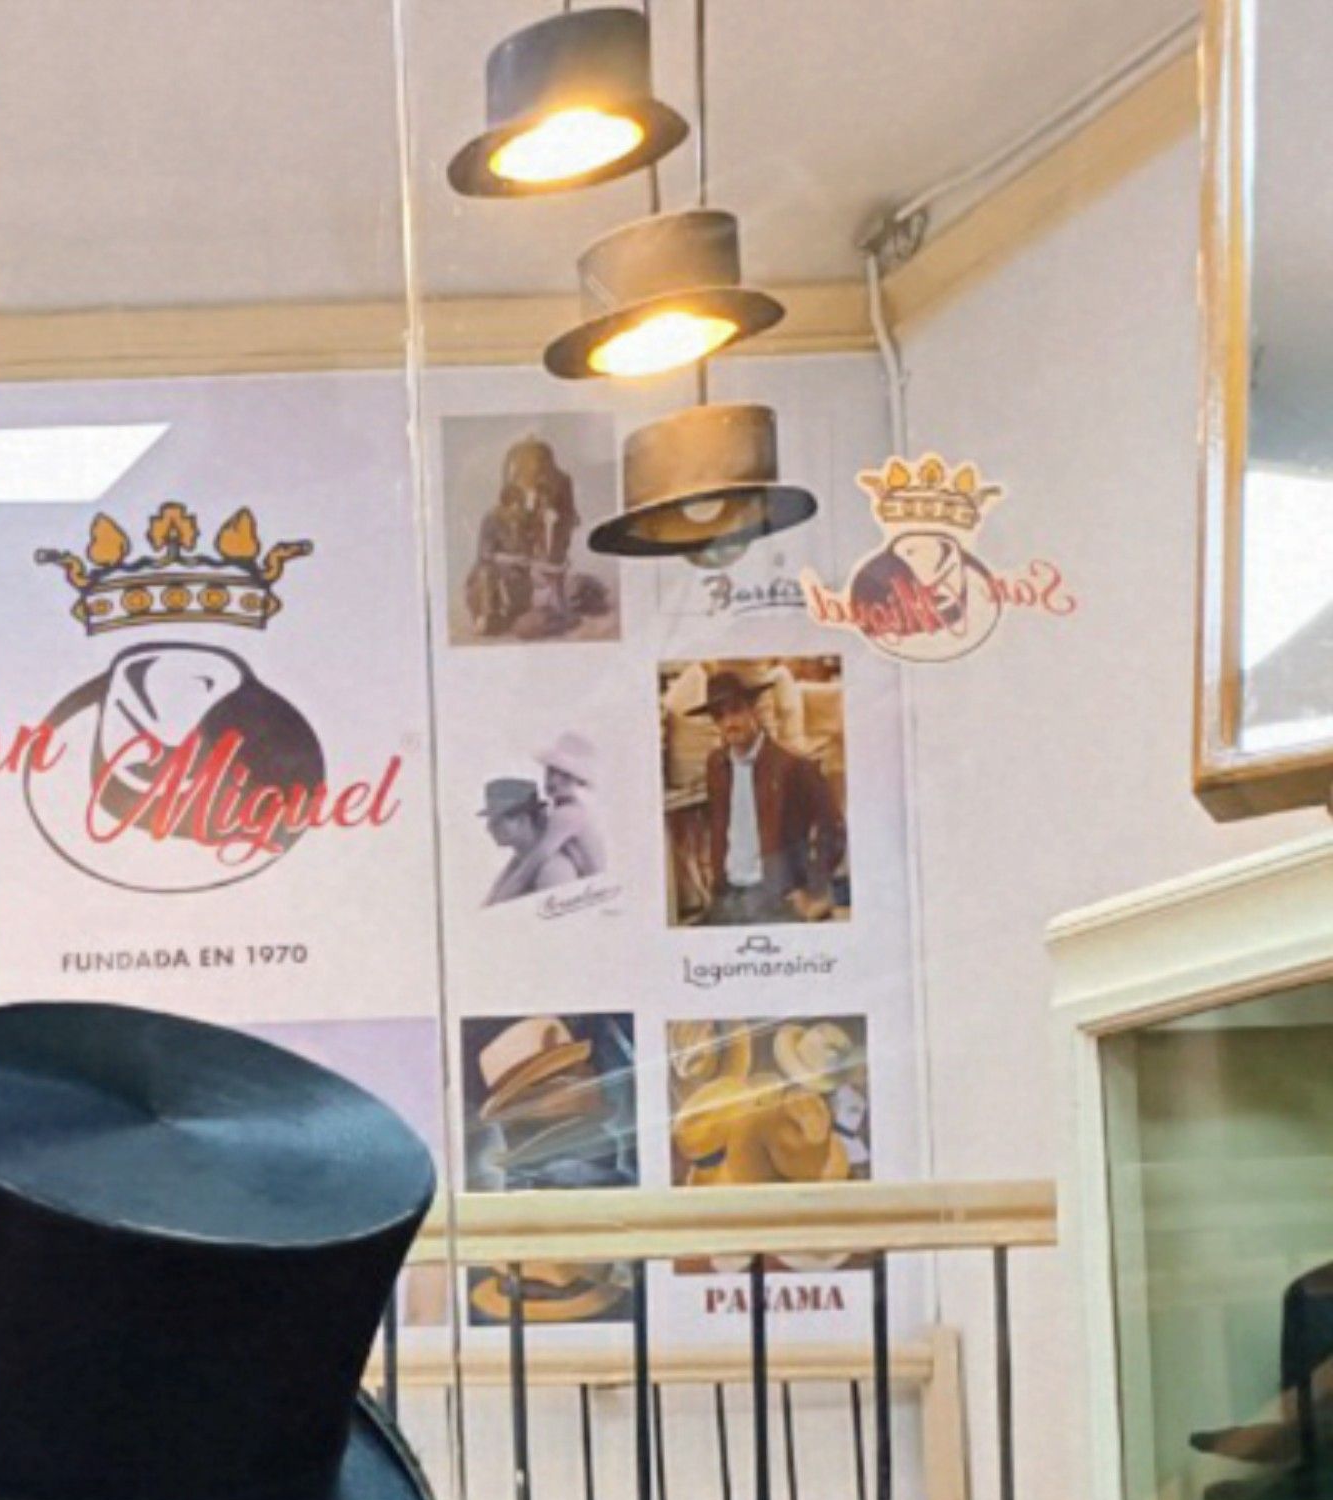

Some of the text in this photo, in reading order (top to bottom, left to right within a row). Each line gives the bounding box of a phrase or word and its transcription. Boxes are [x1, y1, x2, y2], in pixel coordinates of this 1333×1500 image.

[86, 727, 402, 866] Miguel
[62, 942, 309, 973] FUNDADA EN 1970
[705, 1285, 846, 1314] PAAMA
